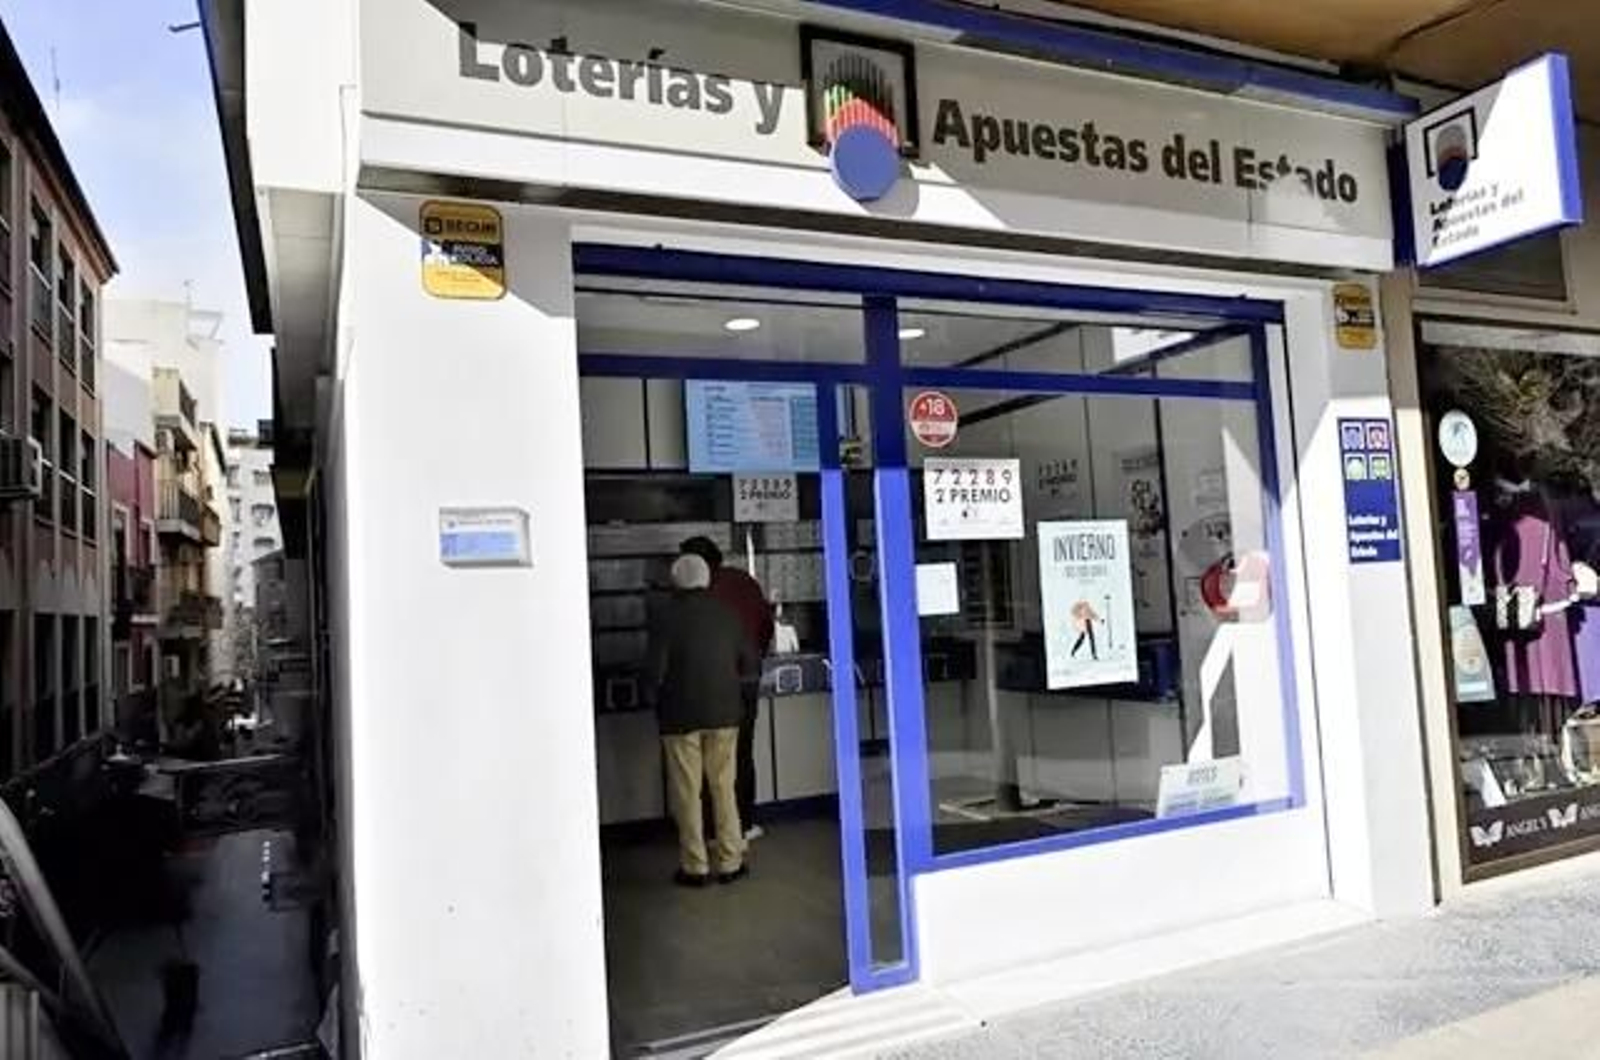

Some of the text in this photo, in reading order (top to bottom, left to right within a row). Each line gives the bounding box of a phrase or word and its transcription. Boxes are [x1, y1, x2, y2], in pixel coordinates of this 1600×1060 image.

[458, 22, 785, 135] Loterías y
[933, 98, 1358, 203] Apuestas del Estado
[950, 488, 1011, 503] PREMIO
[1053, 533, 1116, 563] INVIERNO
